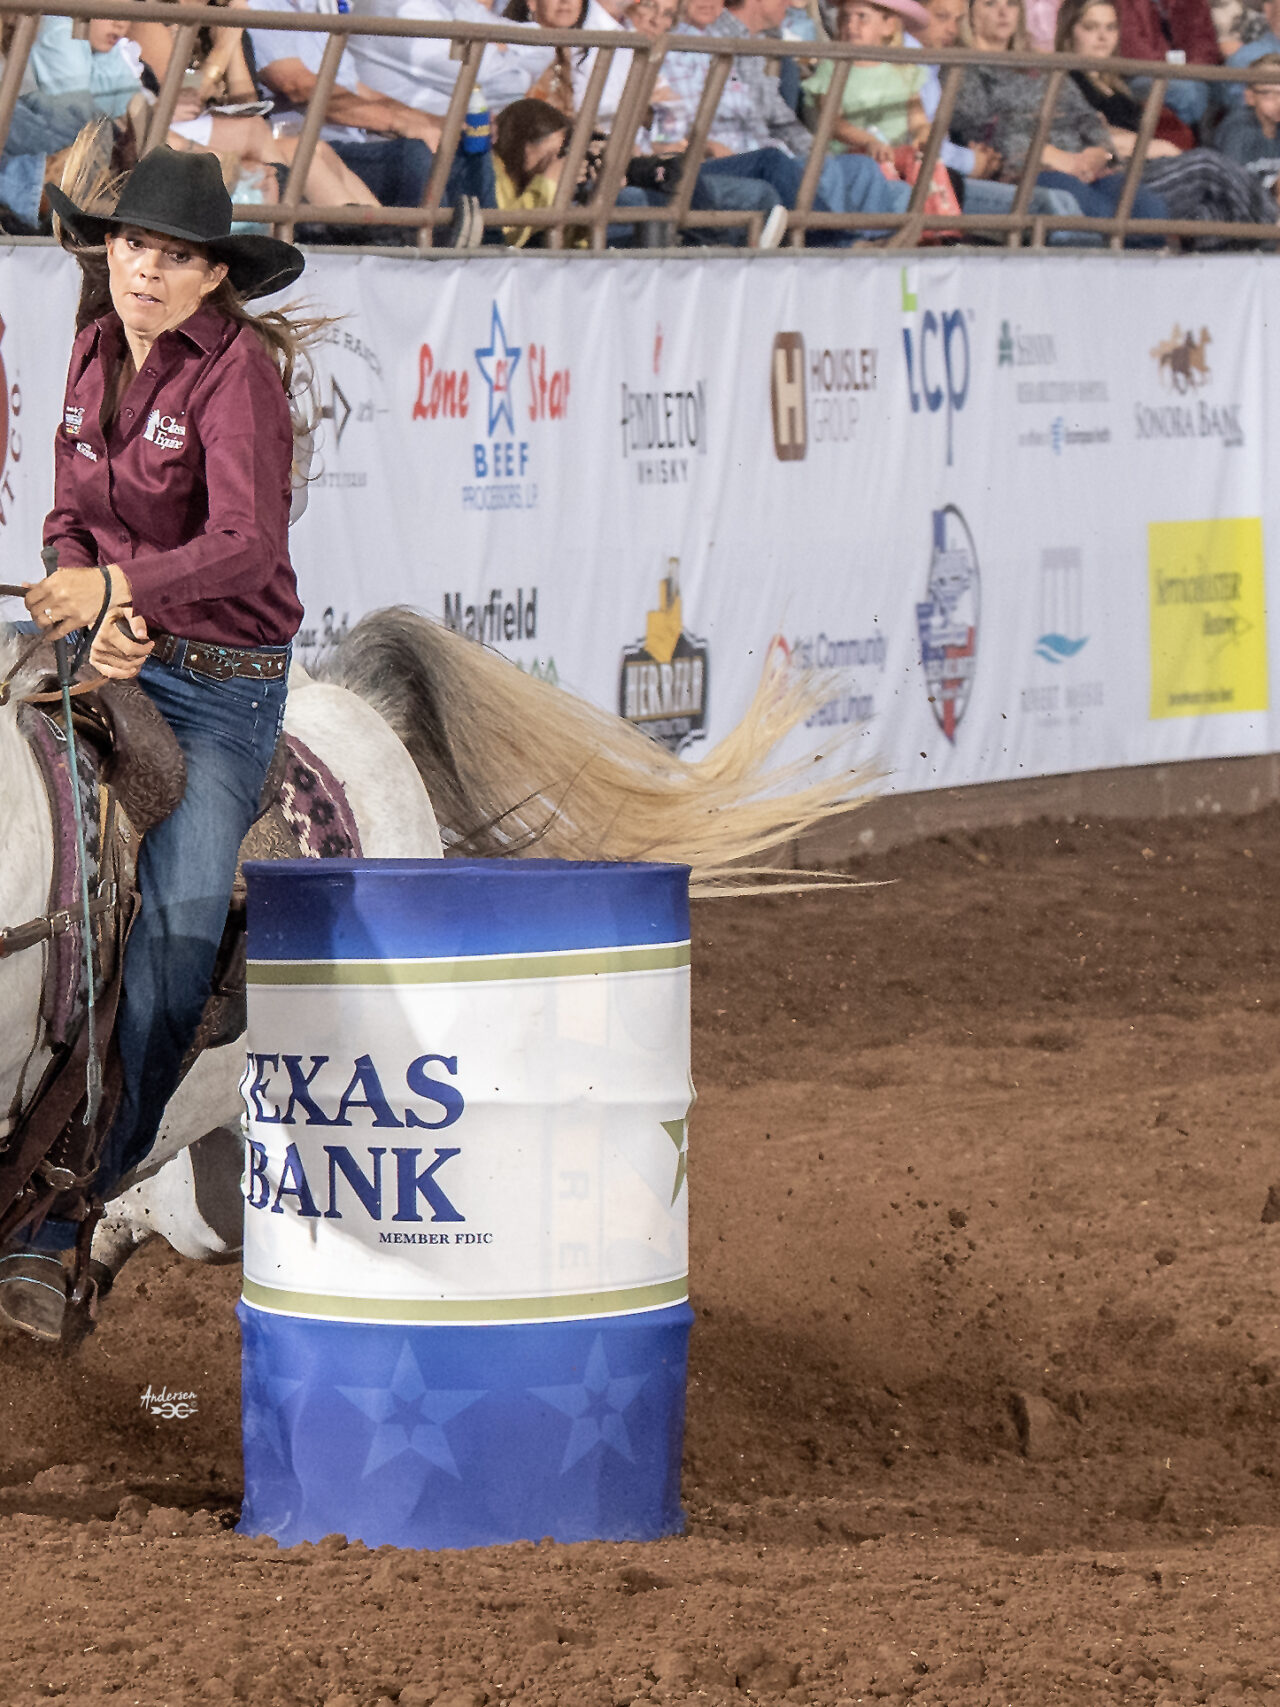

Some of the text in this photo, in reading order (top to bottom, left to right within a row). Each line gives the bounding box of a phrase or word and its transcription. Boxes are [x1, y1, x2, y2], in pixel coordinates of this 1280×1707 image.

[412, 342, 570, 422] Lone Star
[620, 380, 708, 458] PENDLETON
[473, 442, 528, 478] BEEF
[637, 459, 688, 484] WHISKY
[443, 587, 537, 642] Mayfield
[246, 1138, 466, 1222] BANK
[379, 1232, 494, 1244] MEMBER FDIC
